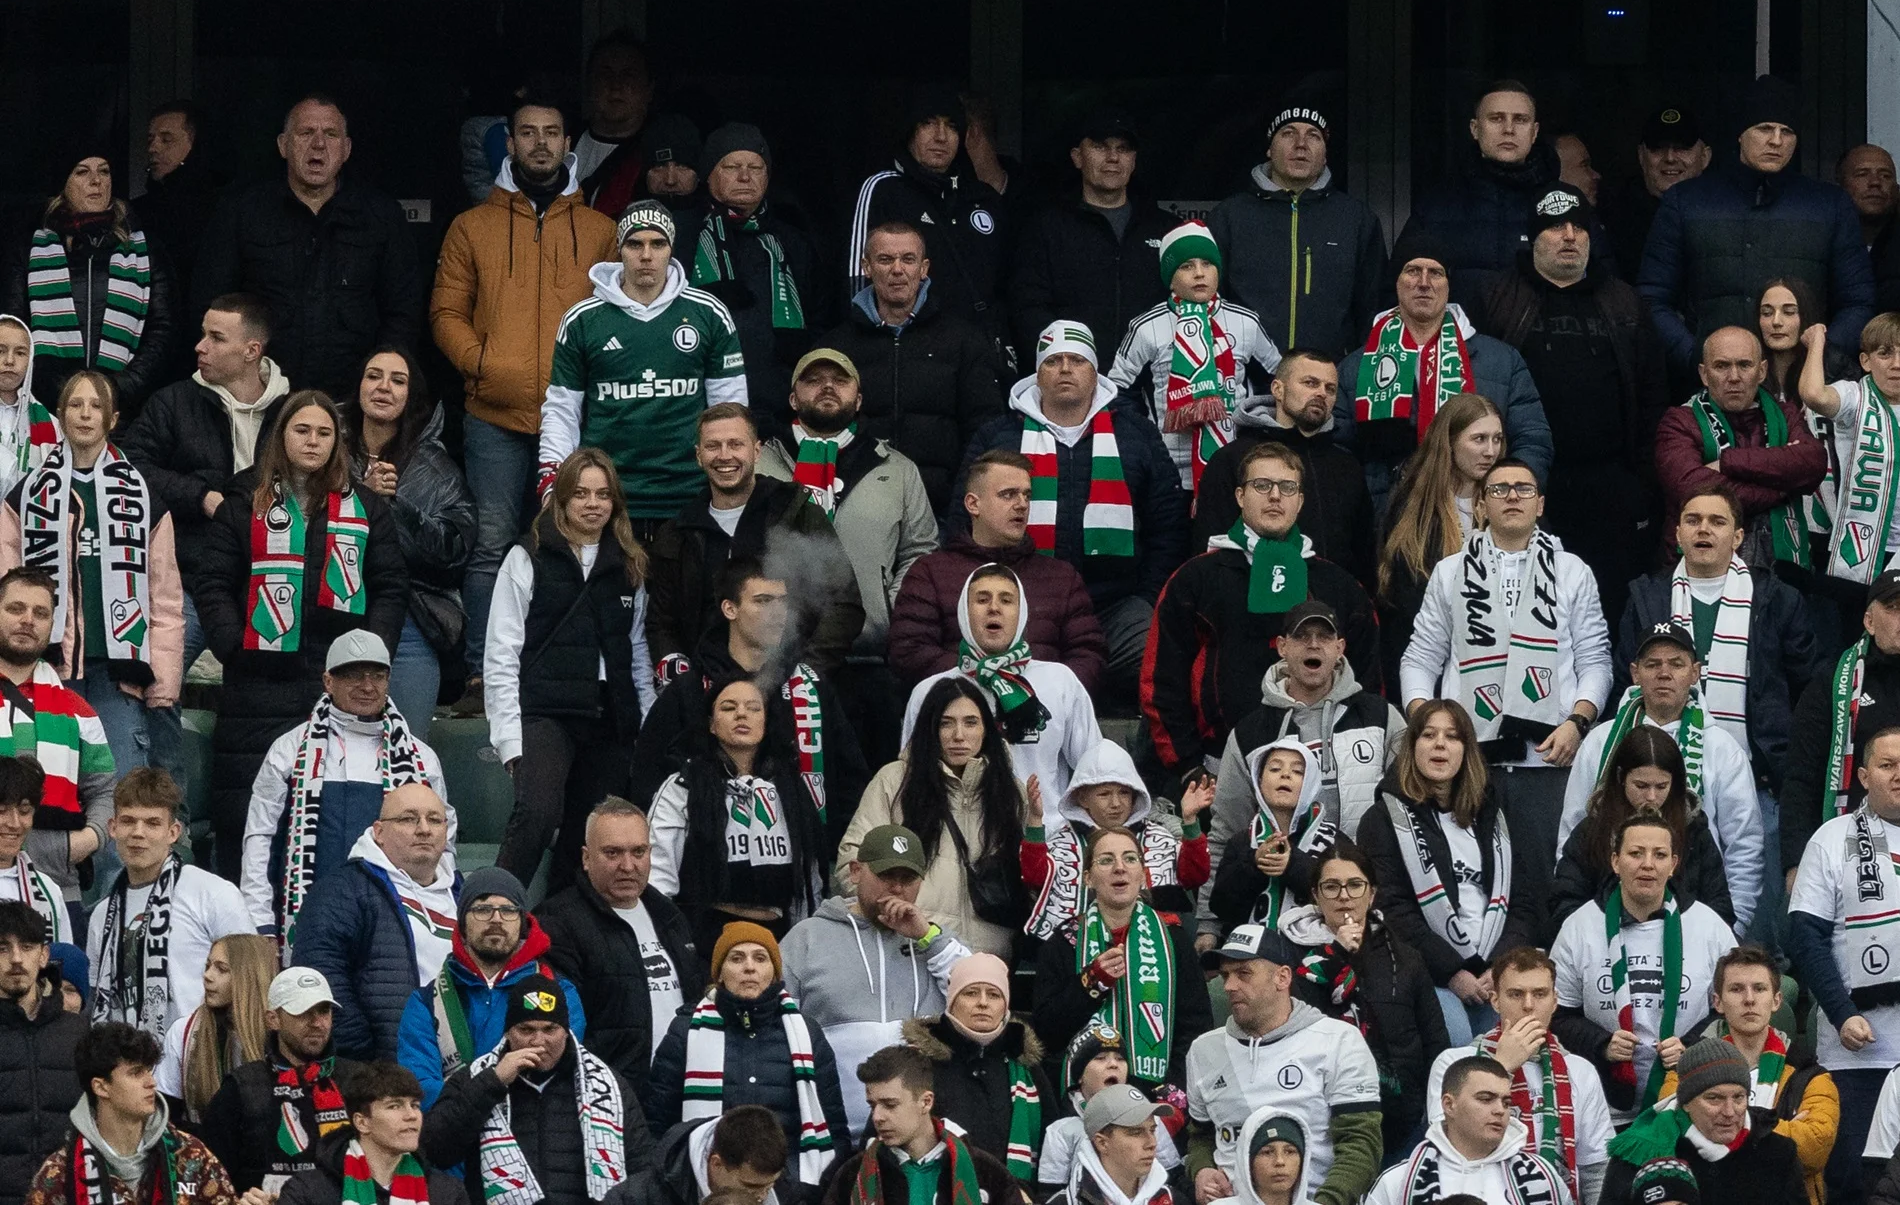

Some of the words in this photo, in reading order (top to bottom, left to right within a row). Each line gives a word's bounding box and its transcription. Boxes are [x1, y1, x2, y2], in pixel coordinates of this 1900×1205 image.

[597, 377, 698, 401] Plus500
[1168, 378, 1216, 403] WARSZAWA
[108, 460, 148, 575] LEGIA
[1465, 536, 1498, 648] SZAWA
[1135, 1055, 1168, 1078] 1916
